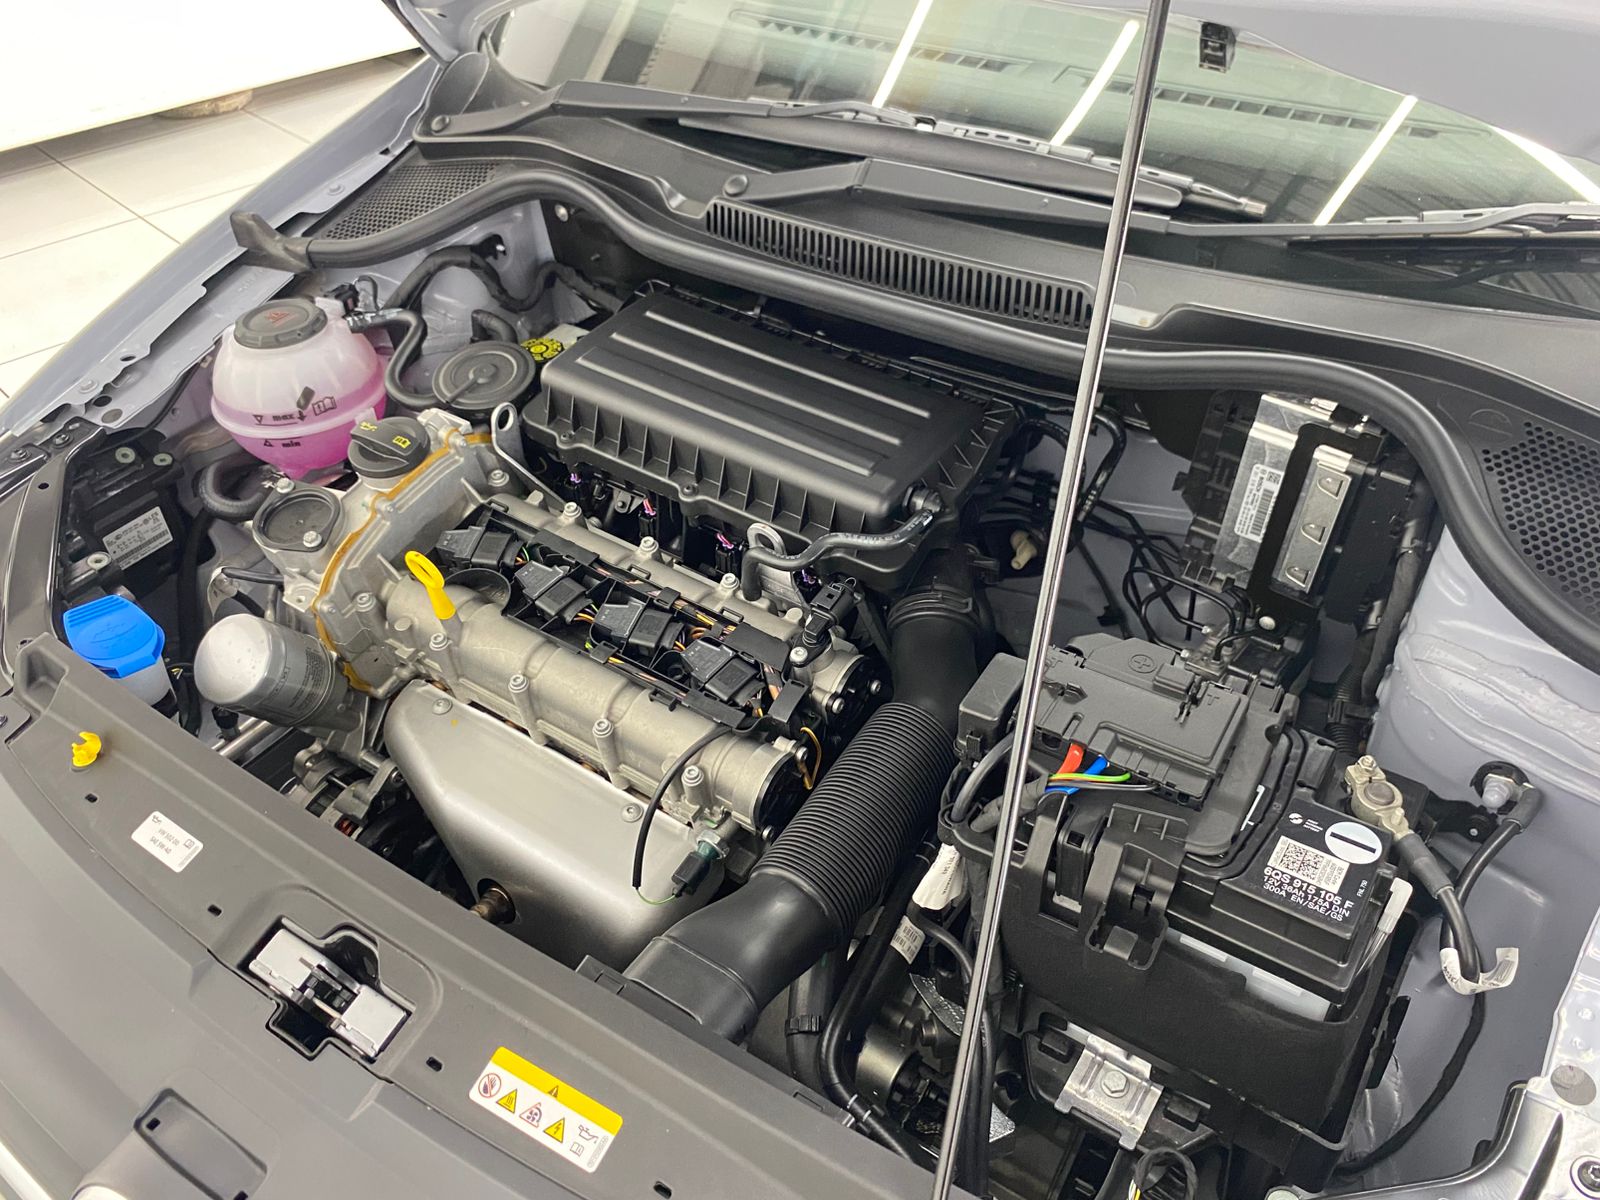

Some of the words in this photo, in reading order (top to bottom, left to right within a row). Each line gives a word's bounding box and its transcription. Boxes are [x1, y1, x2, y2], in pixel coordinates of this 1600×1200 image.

[1263, 866, 1291, 883] 6QS
[1292, 878, 1317, 894] 915
[1319, 890, 1342, 905] 105
[1343, 900, 1355, 909] F
[1263, 876, 1281, 887] 12V
[1281, 883, 1305, 897] 36Ah
[1307, 894, 1330, 909] 175A
[1331, 904, 1350, 917] DIN
[1263, 882, 1286, 897] 300A
[1290, 895, 1344, 921] EN/SAE/GS
